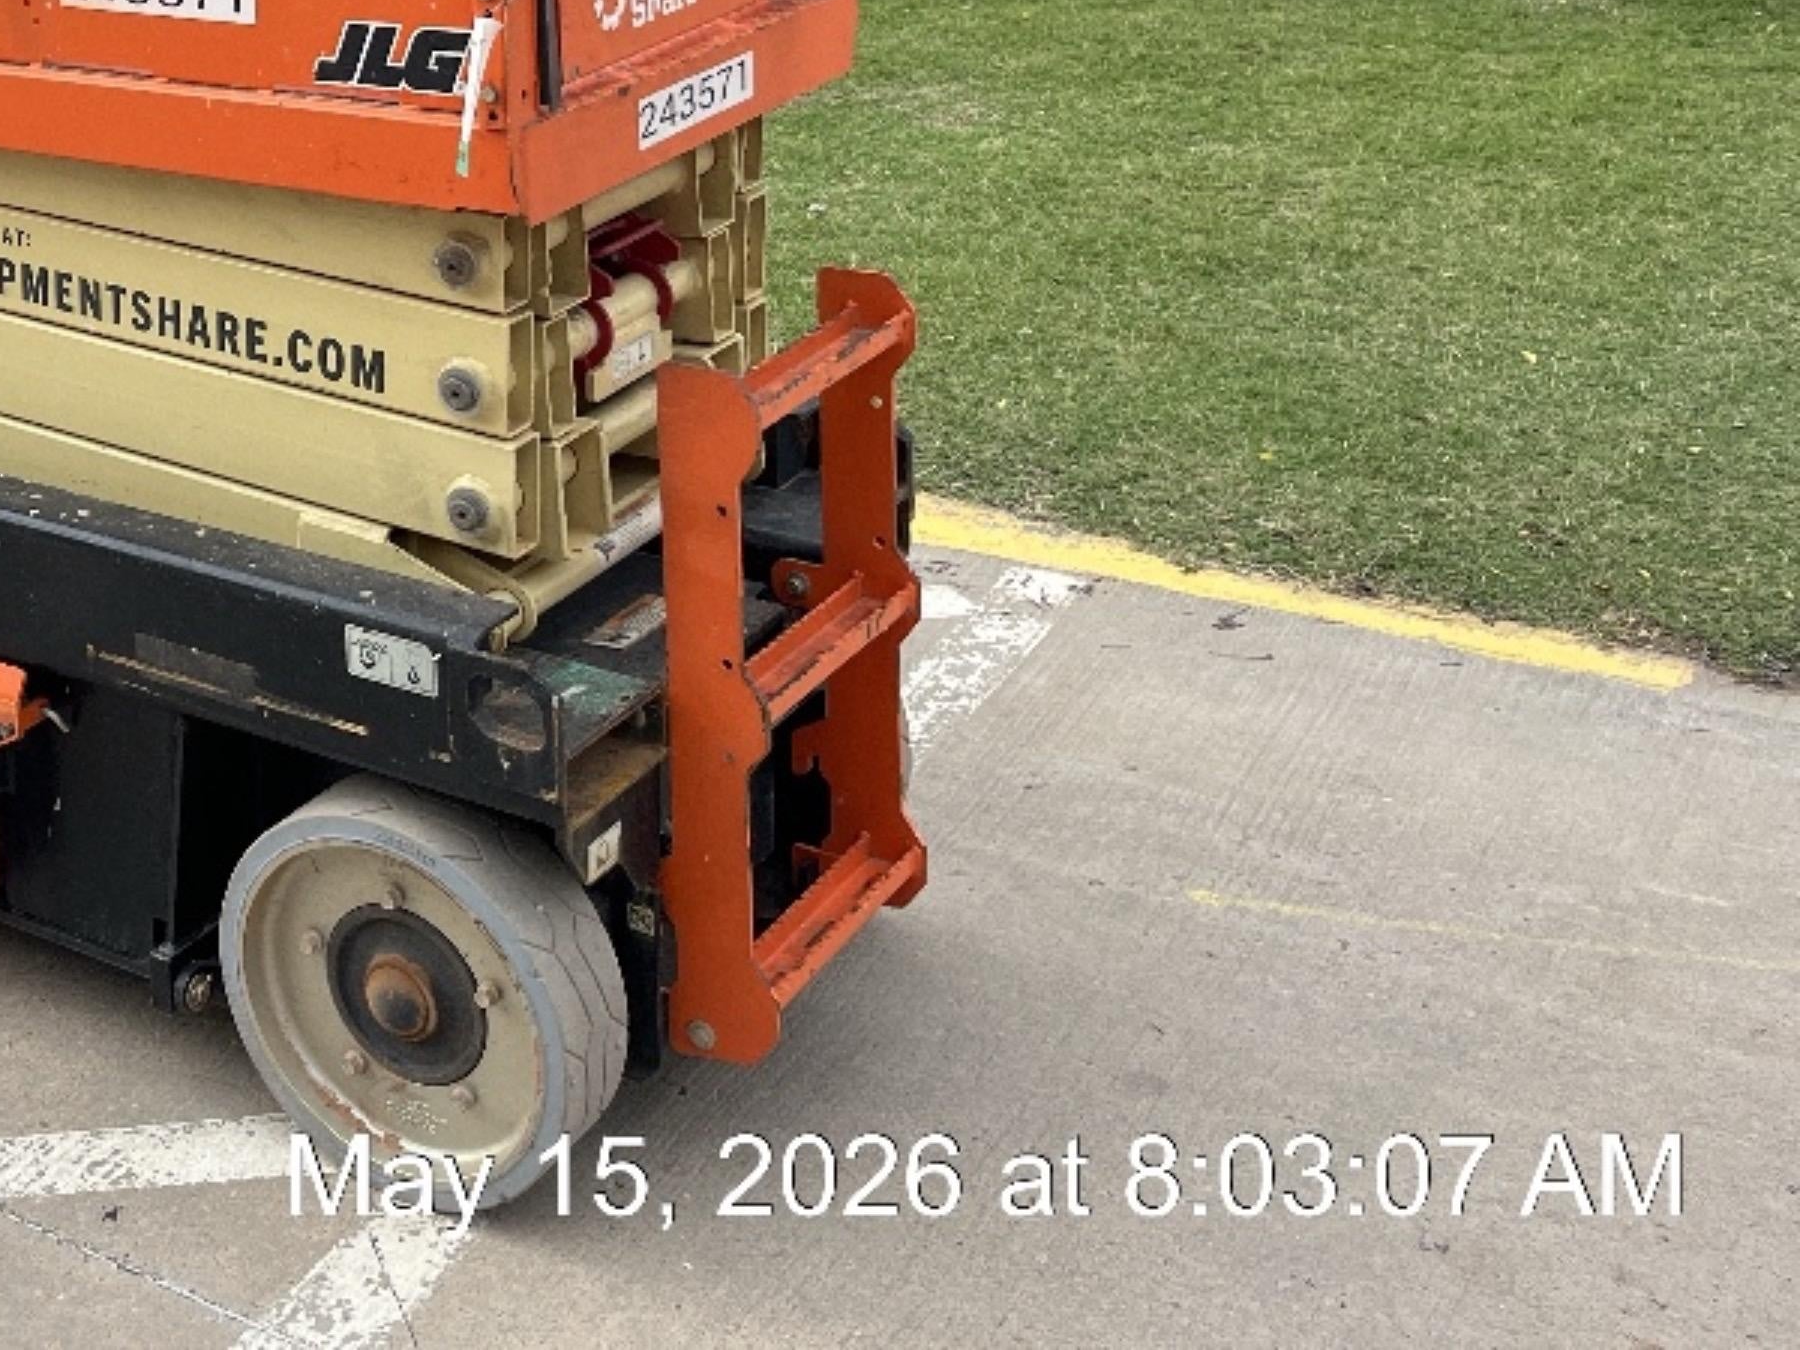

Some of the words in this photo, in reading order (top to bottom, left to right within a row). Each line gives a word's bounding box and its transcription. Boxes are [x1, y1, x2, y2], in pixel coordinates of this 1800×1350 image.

[313, 20, 475, 95] JLG
[640, 59, 748, 140] 243571
[2, 226, 31, 247] AT:
